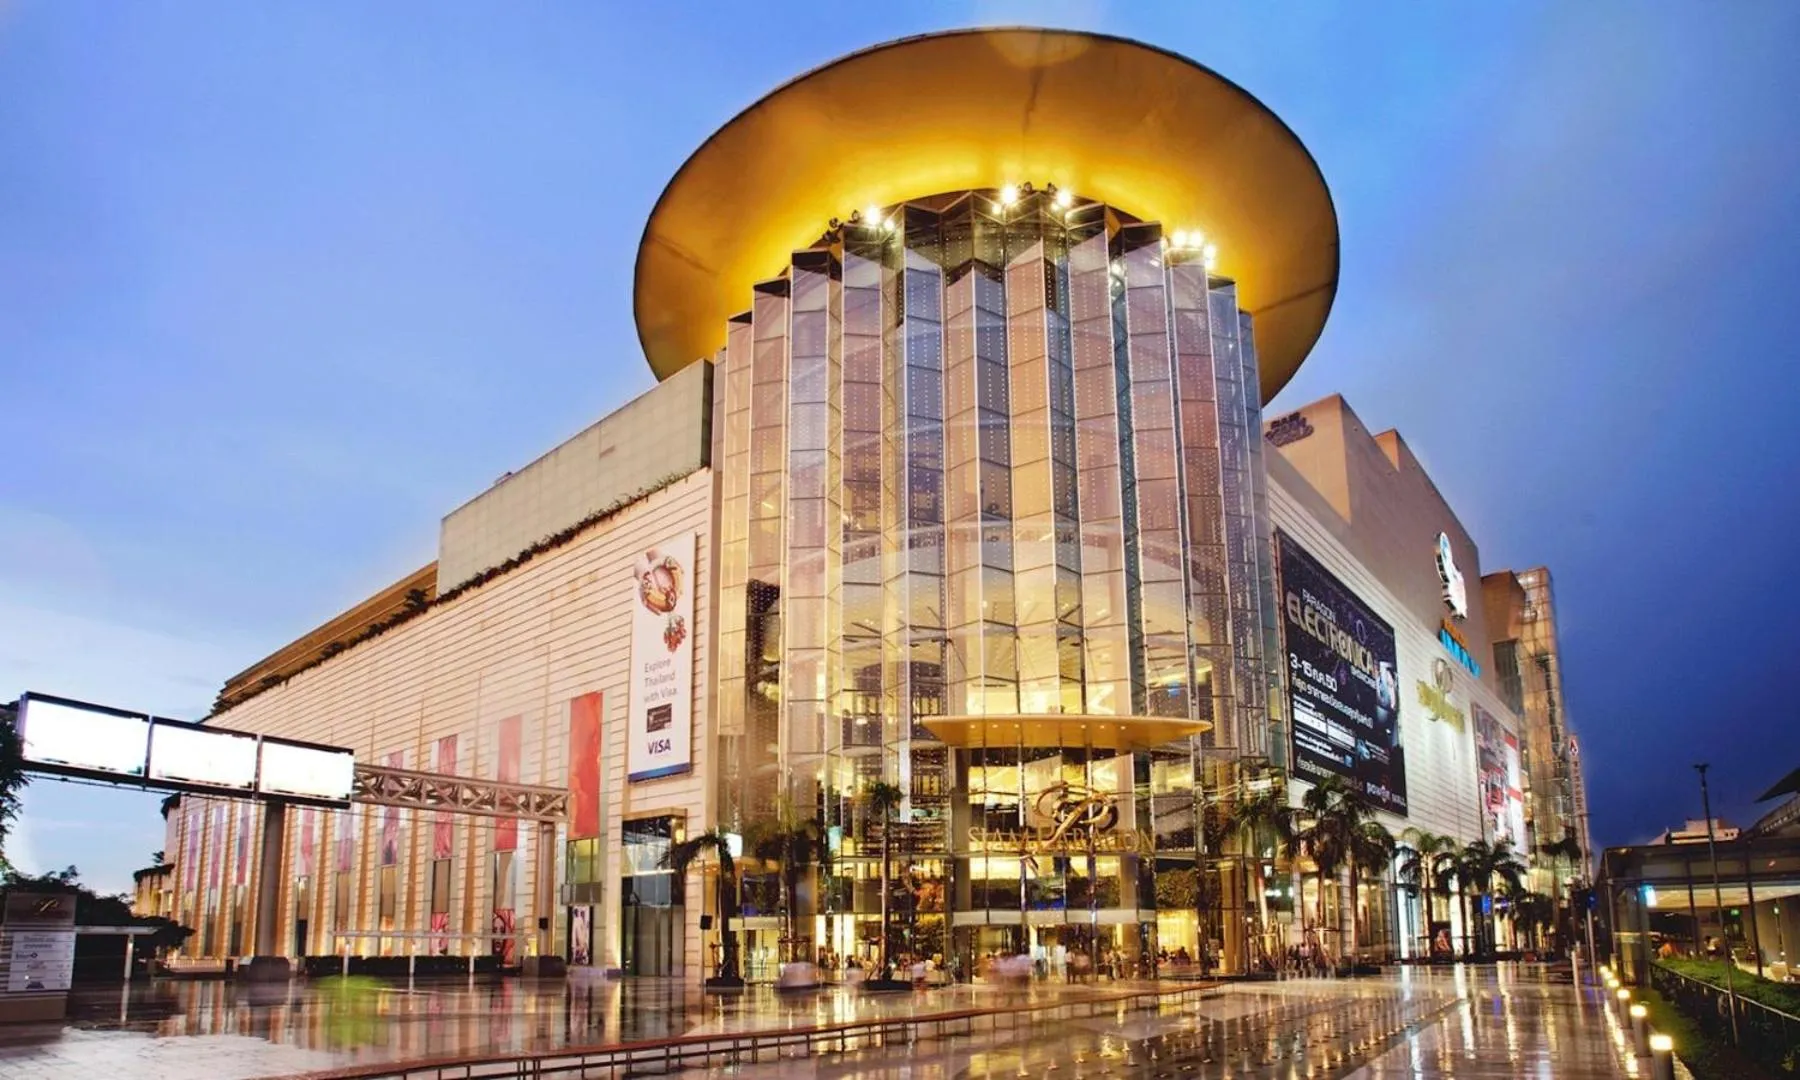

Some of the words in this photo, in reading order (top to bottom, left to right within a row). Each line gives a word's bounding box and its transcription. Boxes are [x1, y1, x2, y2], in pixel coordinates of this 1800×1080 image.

[1286, 591, 1375, 677] ELECTRONICA
[643, 658, 672, 674] Explore
[644, 671, 676, 688] Thailand
[643, 690, 660, 703] with
[660, 686, 678, 700] Visa
[647, 738, 672, 755] VISA
[967, 826, 1028, 852] SIAM
[1036, 822, 1156, 854] PARAGON
